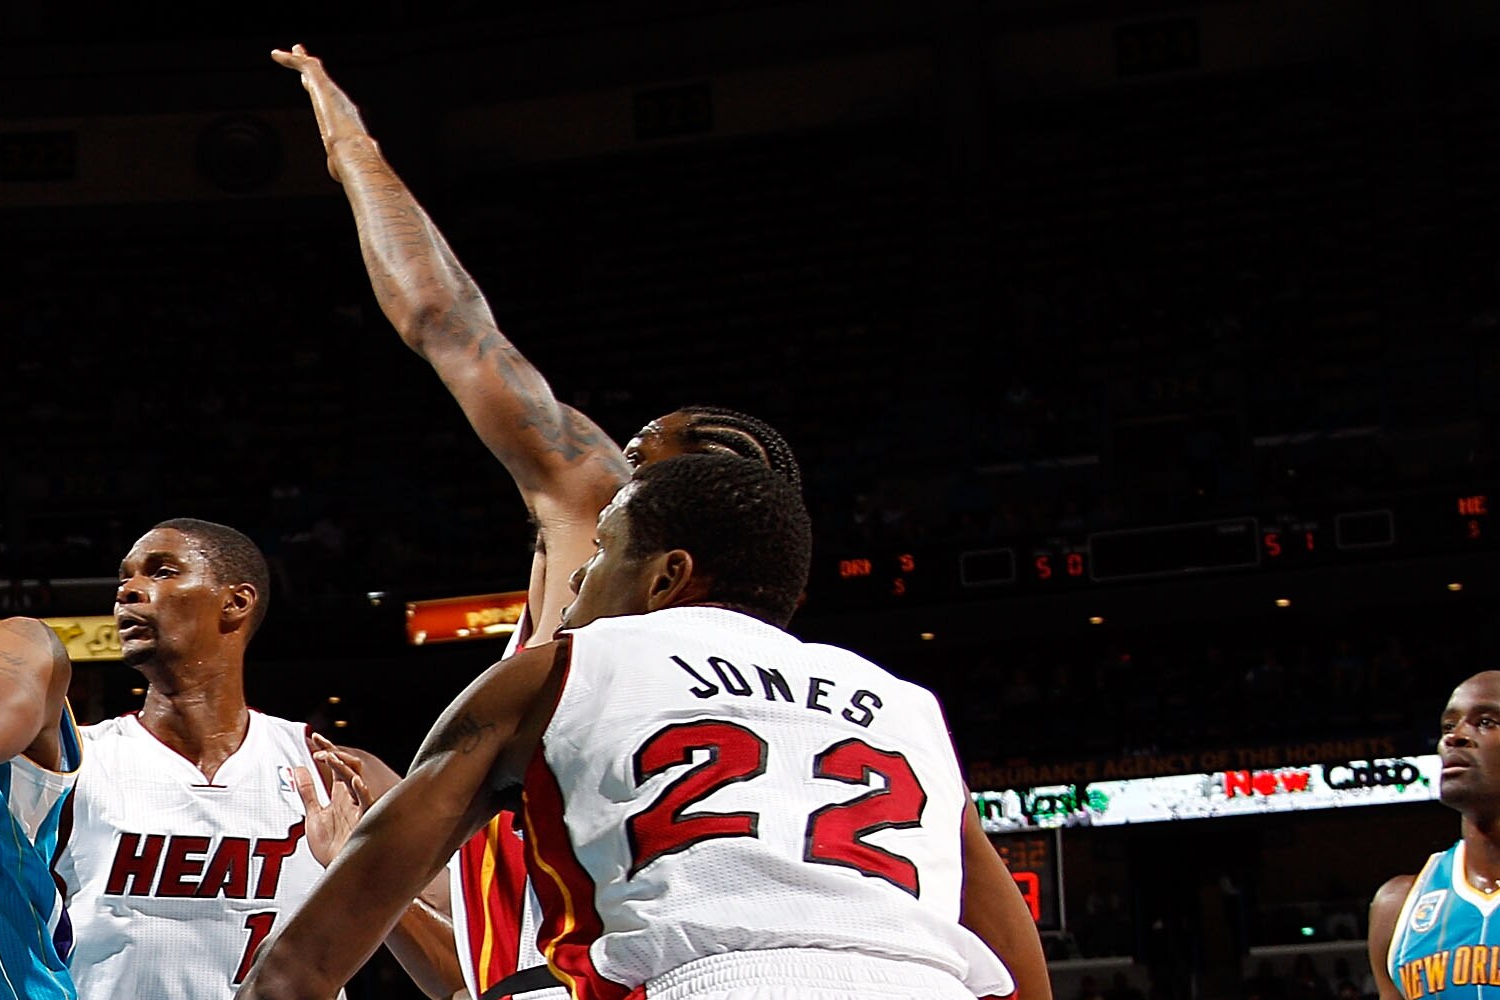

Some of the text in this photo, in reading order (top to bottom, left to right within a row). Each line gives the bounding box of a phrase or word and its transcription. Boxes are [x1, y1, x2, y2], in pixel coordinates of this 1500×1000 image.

[668, 654, 884, 728] JONES
[626, 718, 928, 901] 22
[1223, 769, 1310, 798] New
[104, 816, 305, 900] HEAT
